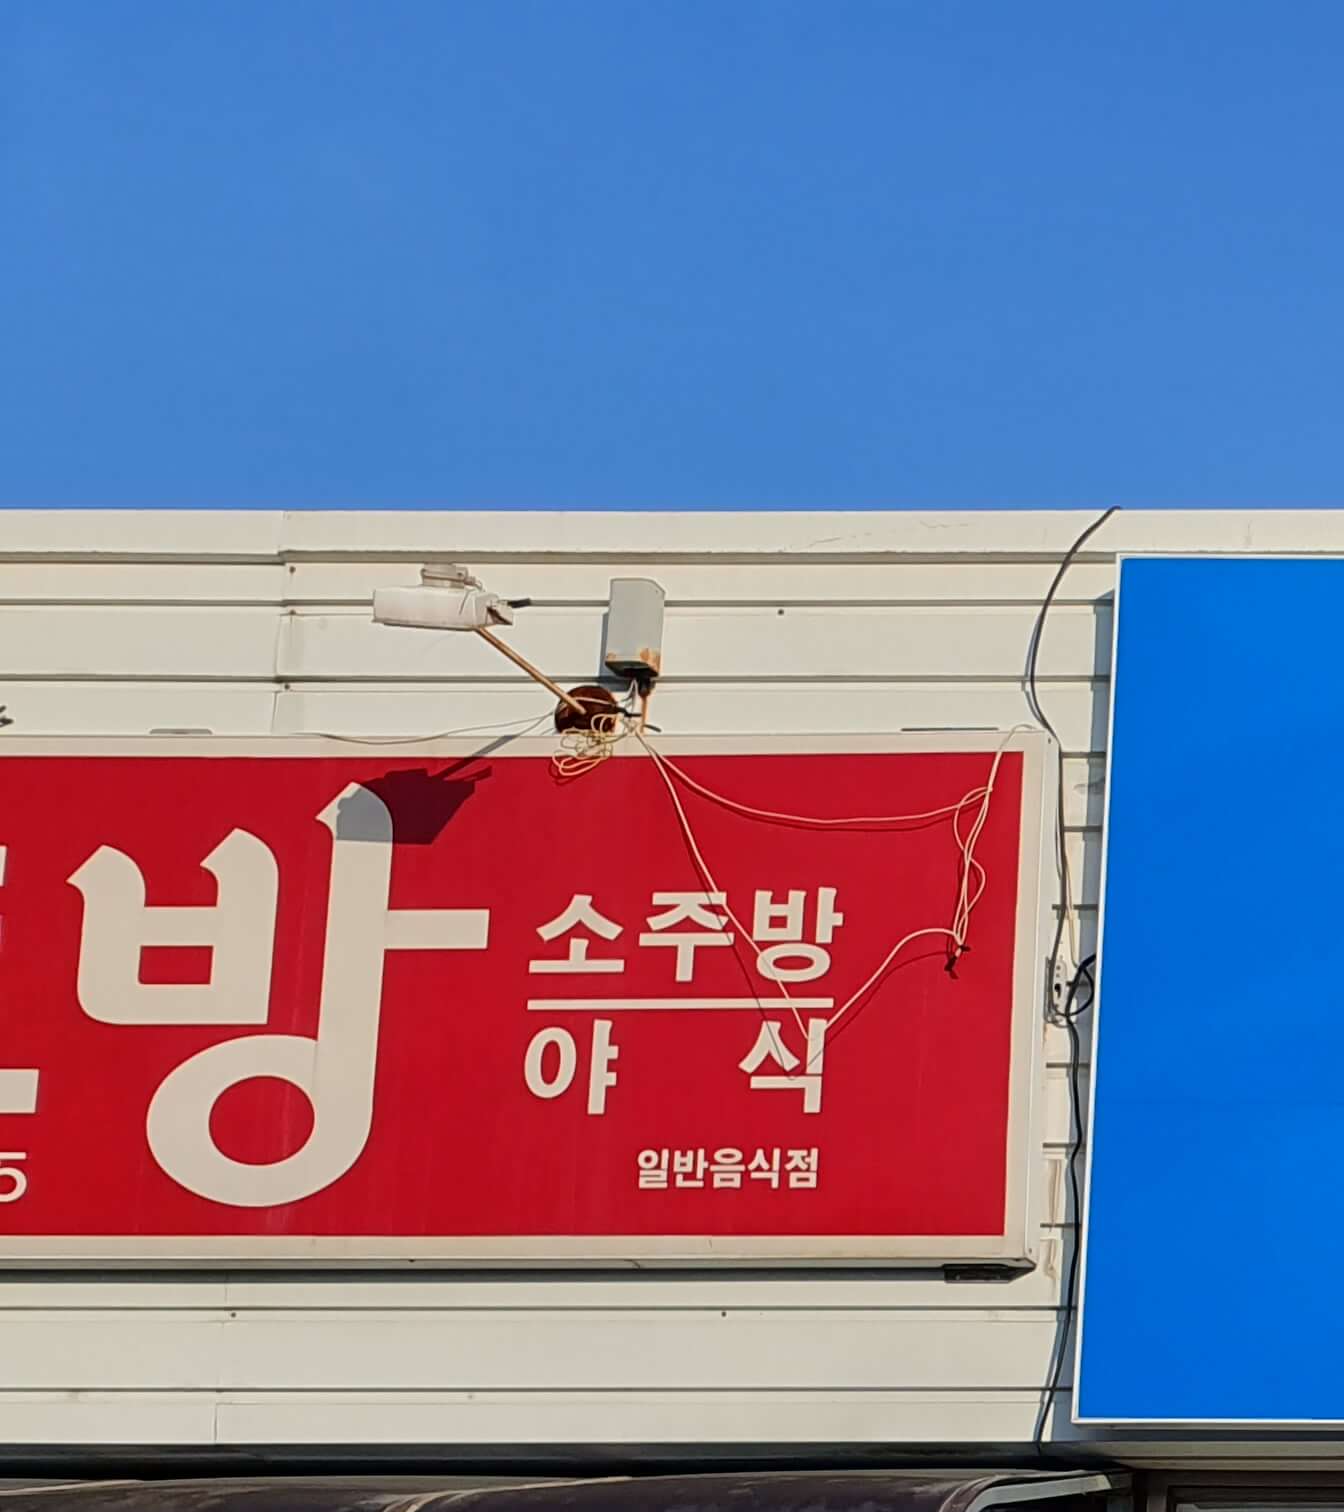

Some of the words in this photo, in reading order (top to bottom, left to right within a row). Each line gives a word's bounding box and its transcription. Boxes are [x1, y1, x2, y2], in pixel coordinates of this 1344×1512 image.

[527, 886, 843, 983] 소주방
[0, 782, 490, 1207] 방
[636, 1147, 820, 1190] 일반음식점
